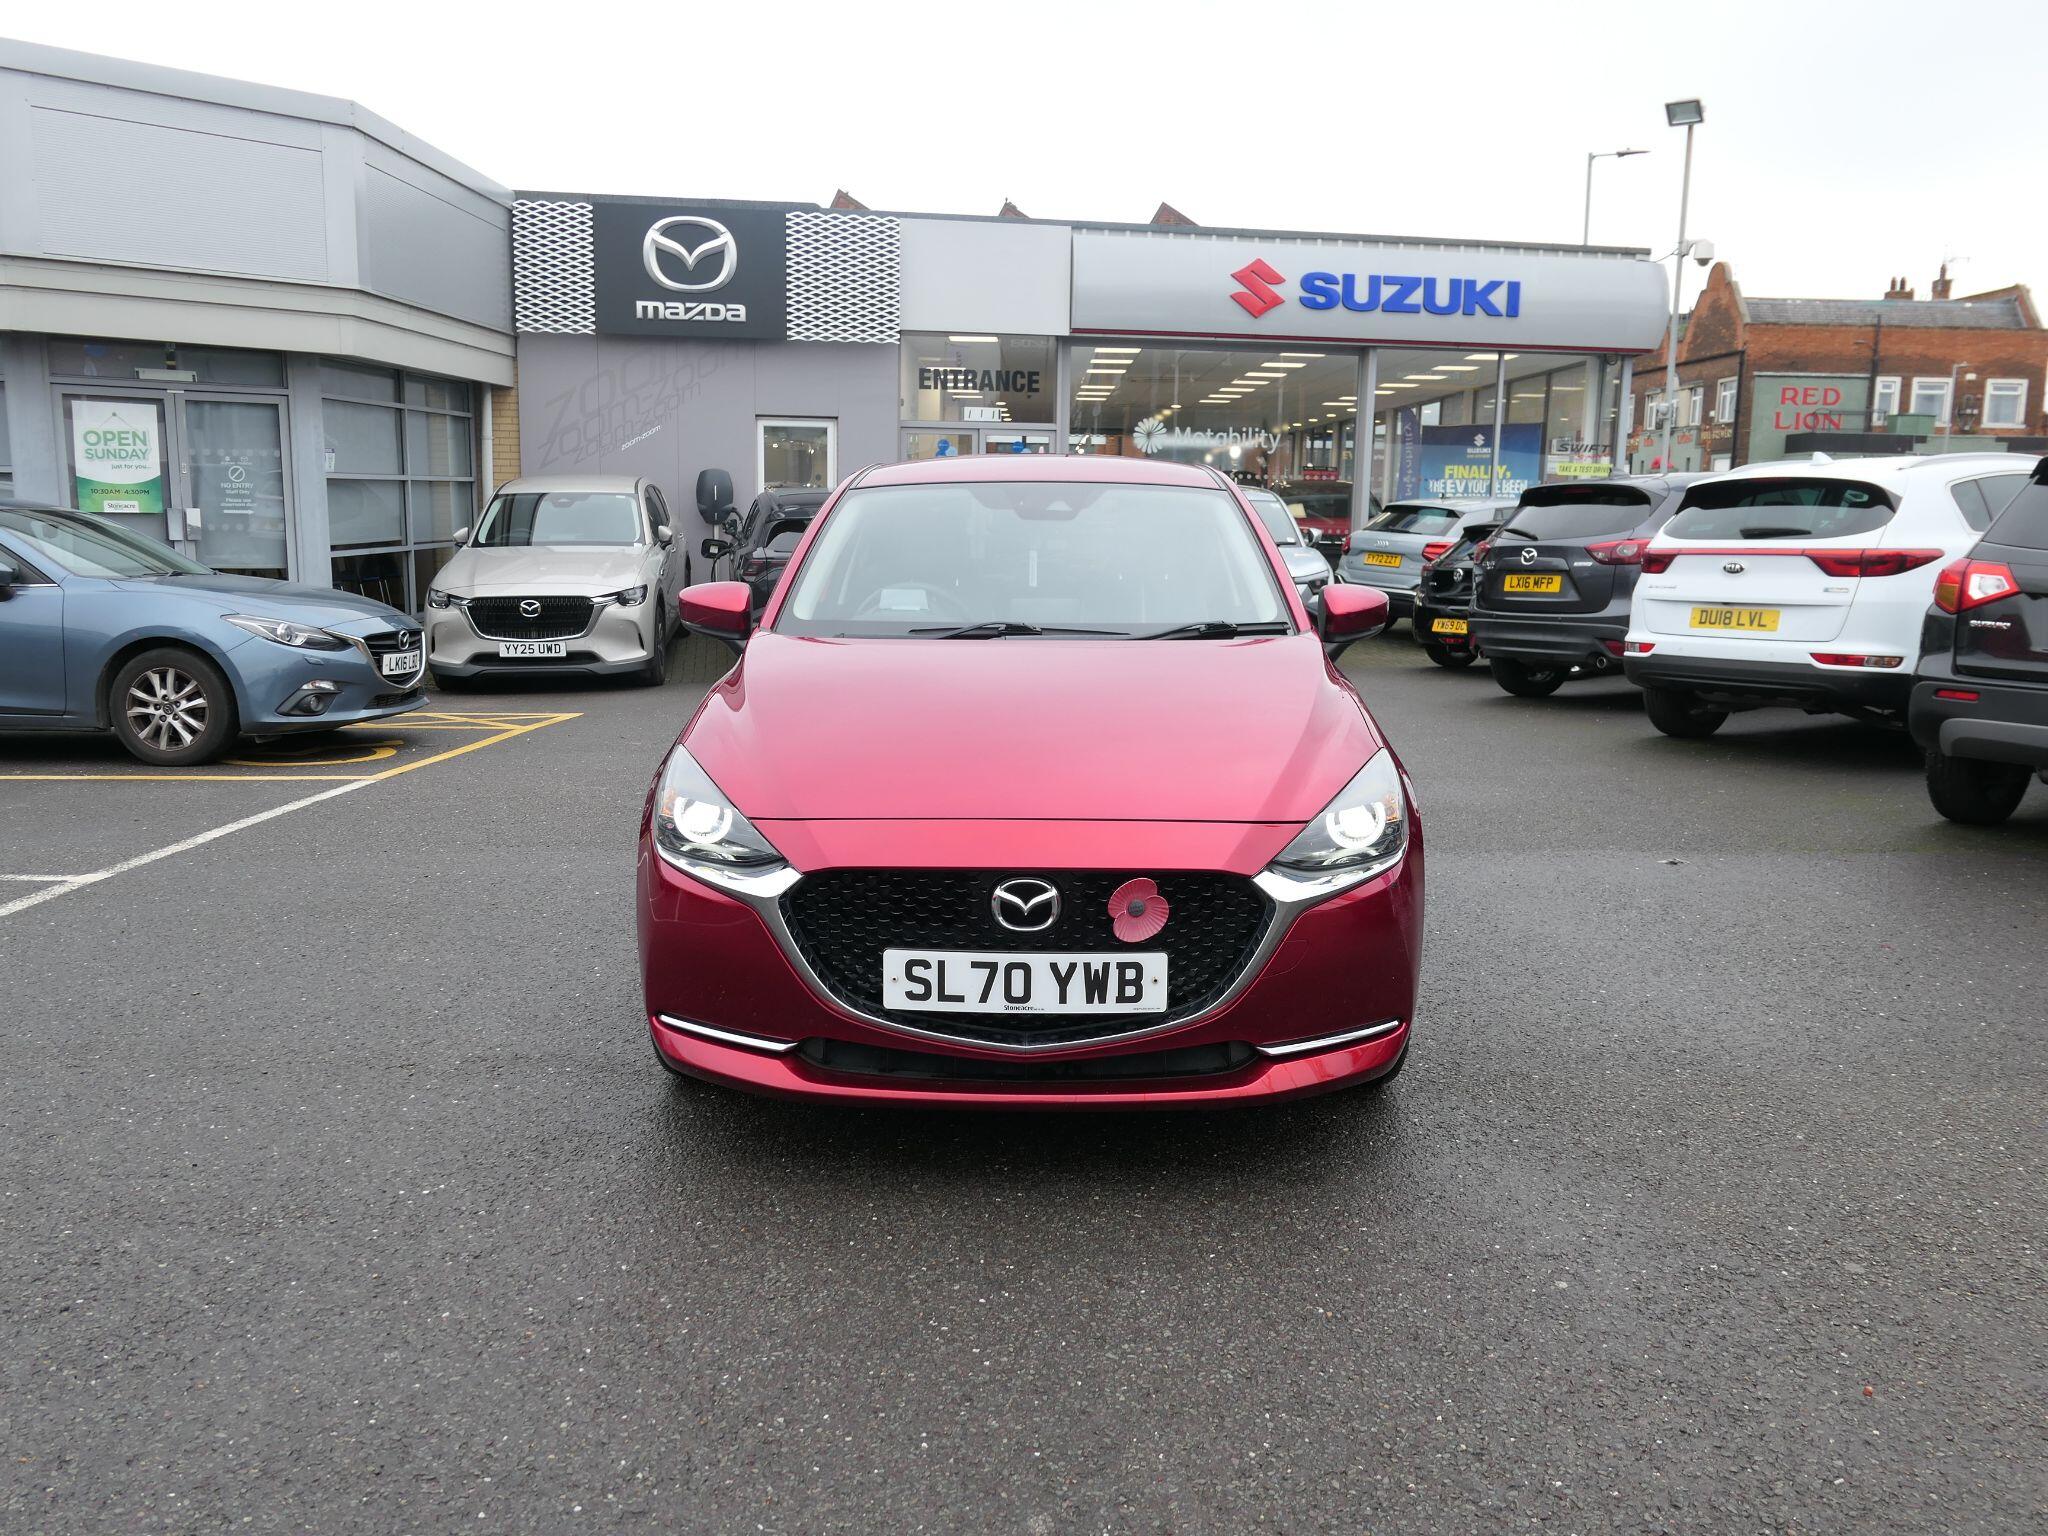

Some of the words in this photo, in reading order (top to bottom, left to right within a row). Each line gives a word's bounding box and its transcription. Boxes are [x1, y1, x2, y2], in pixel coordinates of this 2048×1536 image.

[1299, 272, 1521, 317] SUZUKI
[636, 300, 747, 322] mazda
[918, 367, 1040, 393] ENTRANCE
[1780, 387, 1841, 406] RED
[1774, 411, 1843, 431] LION
[83, 430, 147, 446] OPEN
[621, 424, 662, 451] zoom-zoom
[1174, 426, 1282, 454] Motability
[84, 448, 151, 460] SUNDAY
[1556, 443, 1613, 453] SWIFT
[1444, 464, 1512, 479] FINALY,
[1558, 465, 1572, 473] TAKE
[1446, 480, 1467, 493] EV
[1502, 480, 1529, 494] BEEN
[1509, 576, 1531, 589] LX16
[1532, 577, 1554, 590] MFP
[1698, 610, 1732, 626] DU18
[1736, 612, 1768, 628] LVL
[504, 643, 535, 655] YY25
[538, 643, 562, 654] UWD
[388, 655, 408, 672] LK16
[904, 958, 1032, 1004] SL70
[1049, 961, 1144, 1005] YWB
